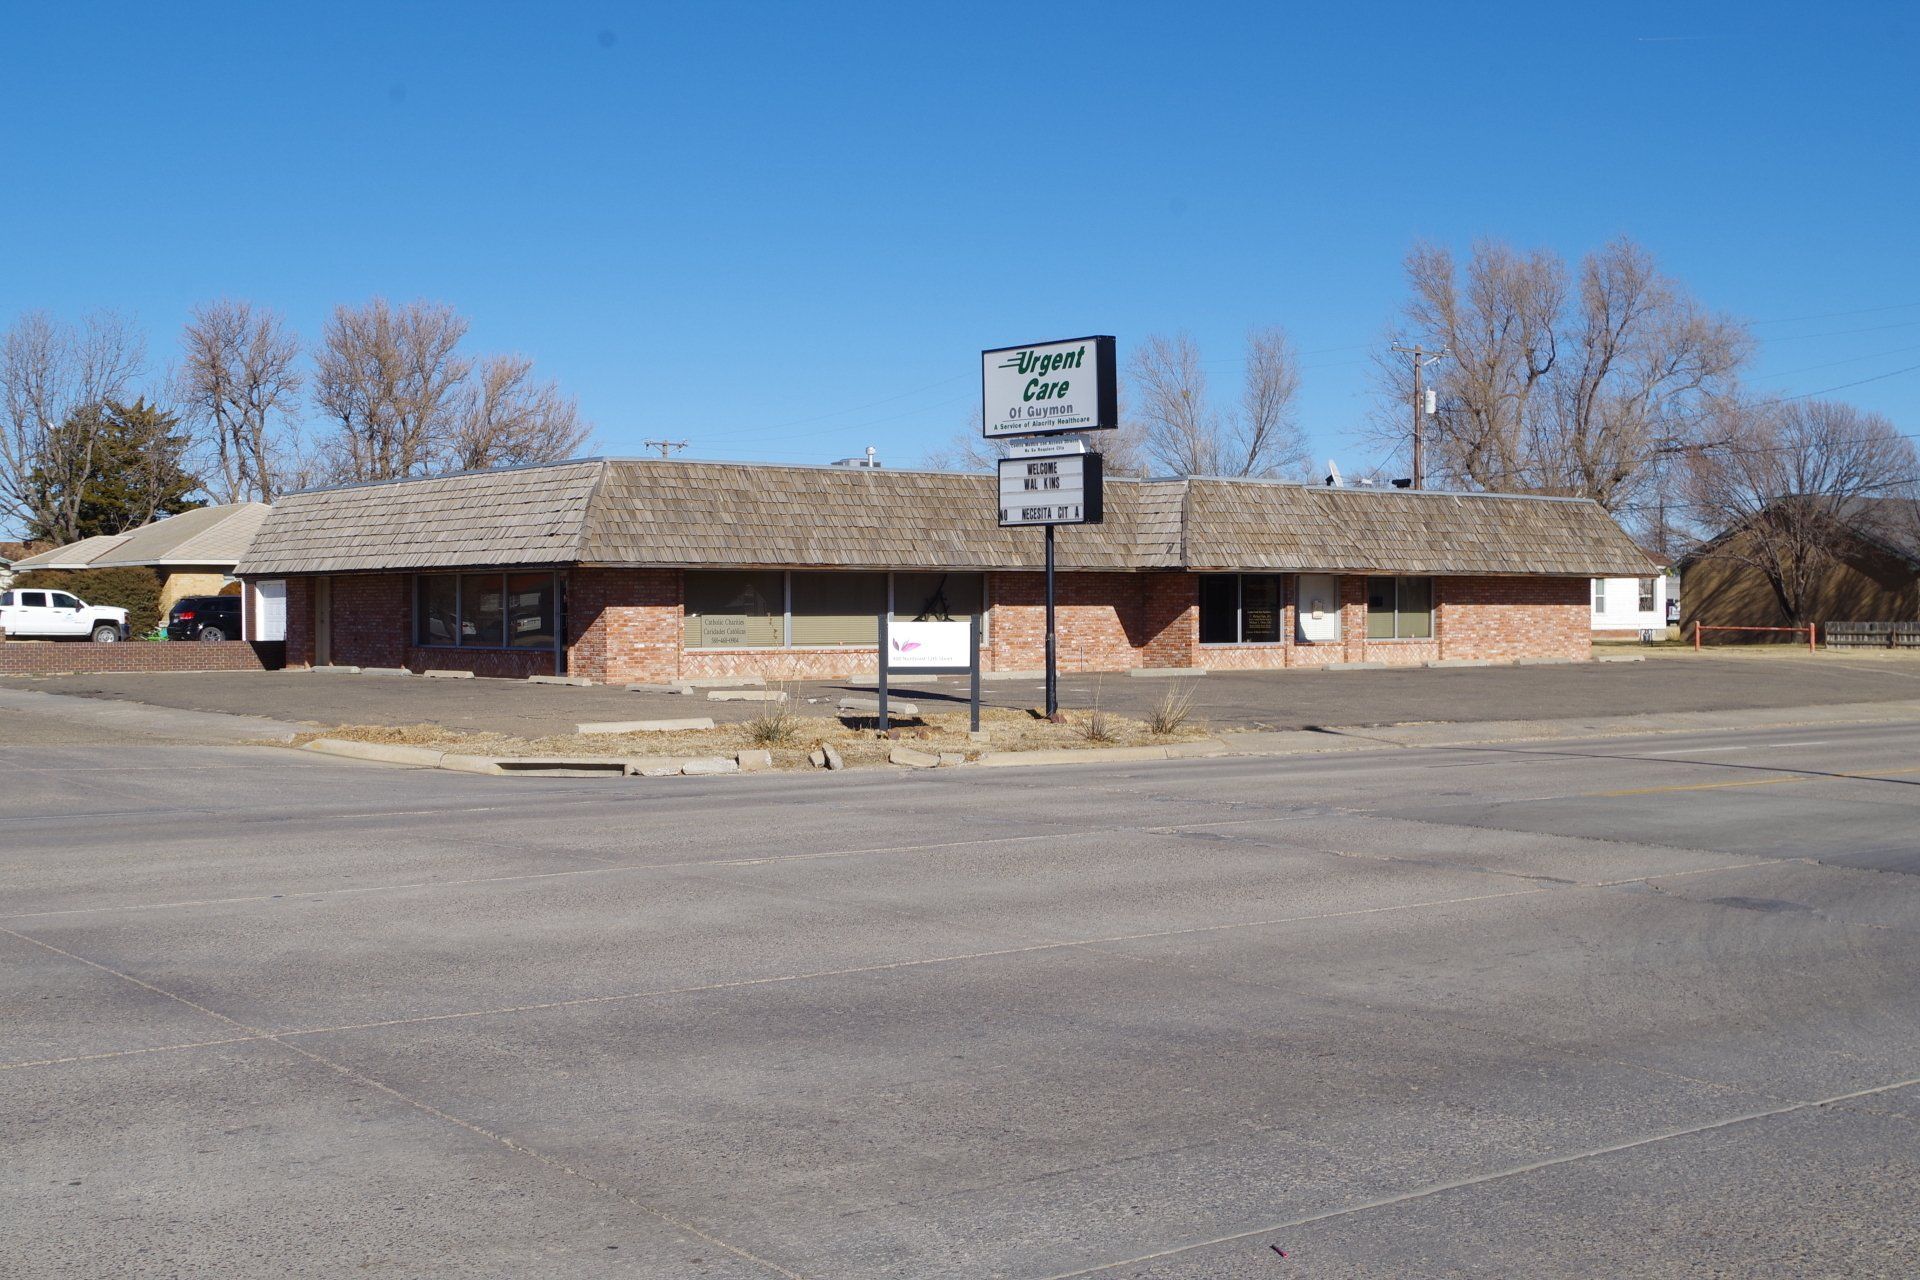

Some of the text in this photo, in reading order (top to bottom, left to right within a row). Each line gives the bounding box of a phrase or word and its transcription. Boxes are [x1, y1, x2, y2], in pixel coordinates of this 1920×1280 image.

[1014, 345, 1086, 377] Urgent
[1023, 378, 1070, 402] Care
[1009, 404, 1073, 419] Of Guymon
[1032, 419, 1055, 427] Alacrity
[1057, 416, 1090, 425] Healthcare
[1027, 461, 1058, 475] WELCOME
[1022, 506, 1052, 520] NECESITA
